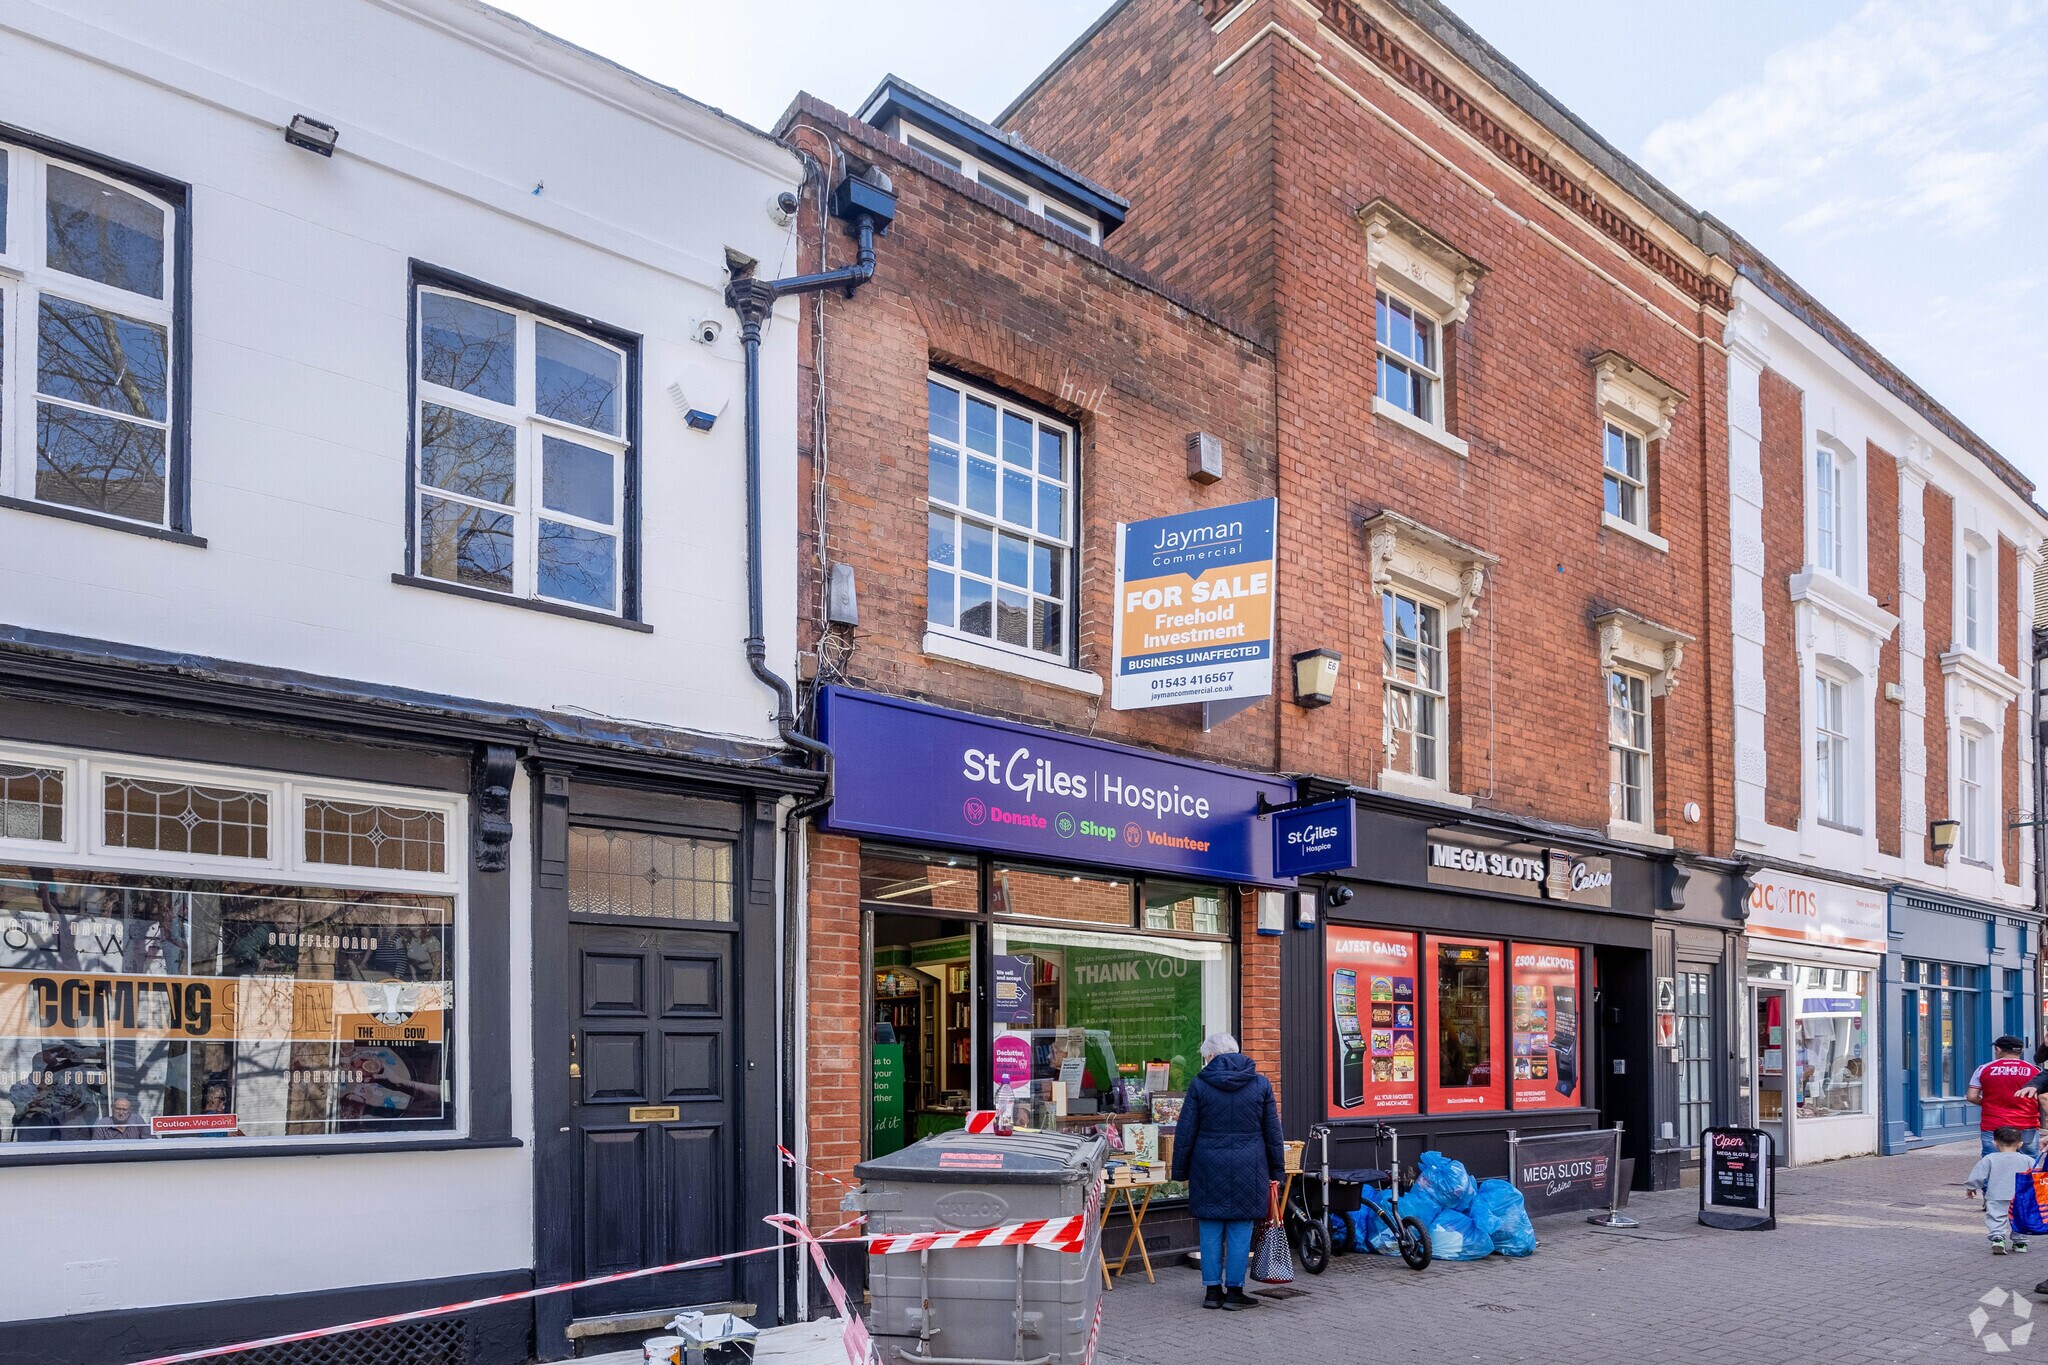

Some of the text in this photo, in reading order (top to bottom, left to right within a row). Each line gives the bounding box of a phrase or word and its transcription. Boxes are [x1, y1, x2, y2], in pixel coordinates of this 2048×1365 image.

[1153, 521, 1243, 550] Jayman
[1152, 543, 1242, 567] Commercial
[1126, 573, 1267, 613] FOR SALE
[1155, 603, 1234, 630] Freehold
[1143, 622, 1245, 649] Investment
[1128, 645, 1260, 670] BUSINESS UNAFFECTED
[1327, 661, 1337, 671] E6
[1151, 671, 1235, 690] 01543 416567
[1150, 684, 1234, 701] jaymancommercial.co.uk
[963, 748, 1210, 819] St Giles Hospice
[990, 807, 1210, 852] Donate Shop Volunteer
[1288, 825, 1338, 845] St Giles
[1306, 842, 1332, 853] Hospice
[1433, 844, 1612, 892] MEGA SLOTS Casino
[1751, 882, 1817, 917] acorns
[70, 921, 124, 938] DARTS
[268, 932, 378, 951] SHUFFLEBOARD
[1335, 940, 1408, 958] LATEST GAMES
[1074, 957, 1188, 985] THANK YOU
[1515, 955, 1574, 970] £500 JACKPOTS
[27, 977, 334, 1036] COMING SOON
[357, 1026, 426, 1039] THE DIRTY COW
[996, 1049, 1025, 1057] Declutter,
[64, 1070, 108, 1085] FOOD
[283, 1070, 363, 1084] COCKTAILS
[874, 1070, 892, 1079] your
[156, 1118, 234, 1128] Caution. Wet paint.
[1712, 1134, 1744, 1149] Open
[1523, 1161, 1592, 1183] MEGA SLOTS
[1546, 1180, 1572, 1197] Casino
